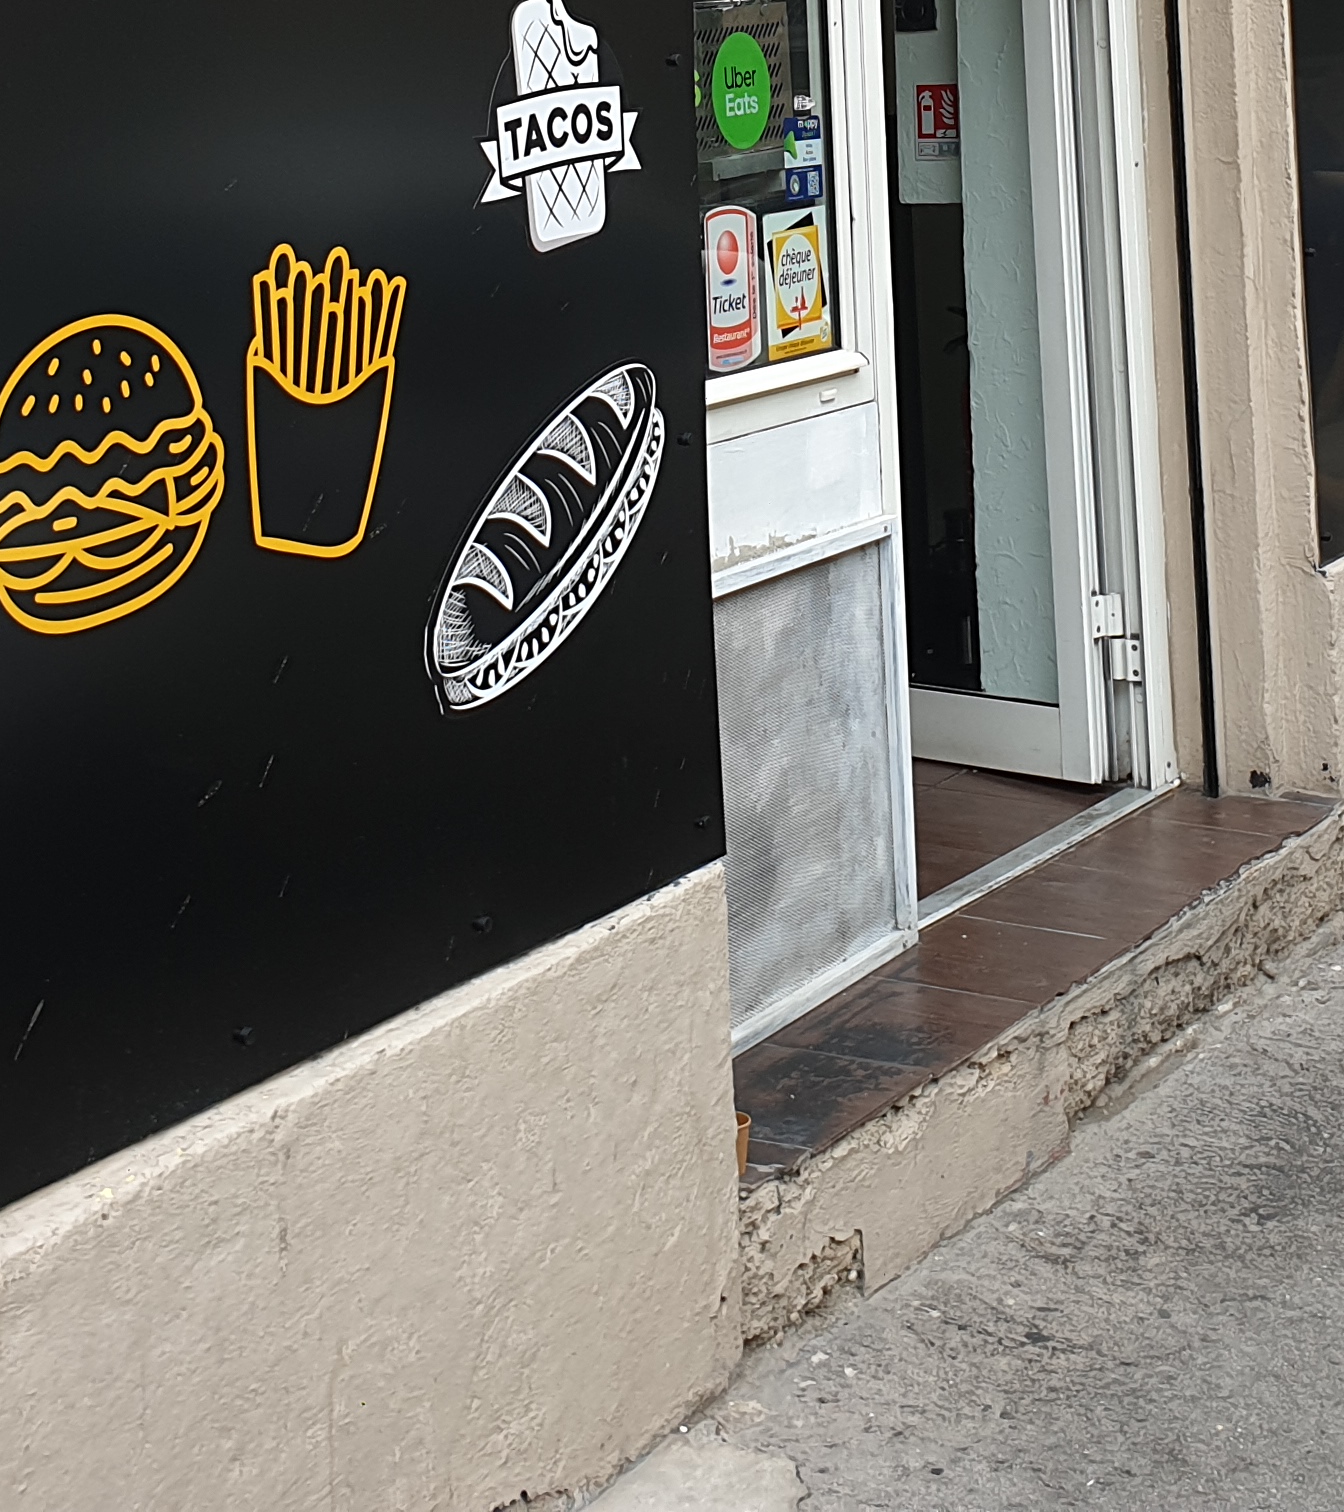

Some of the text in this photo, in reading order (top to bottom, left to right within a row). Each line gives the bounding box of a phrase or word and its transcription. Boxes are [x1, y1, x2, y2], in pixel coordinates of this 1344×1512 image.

[723, 65, 757, 90] Uber
[725, 92, 759, 117] Eats
[503, 100, 613, 161] TACOS
[780, 248, 812, 268] chèque
[778, 266, 816, 289] déjeuner
[712, 292, 747, 315] Ticket
